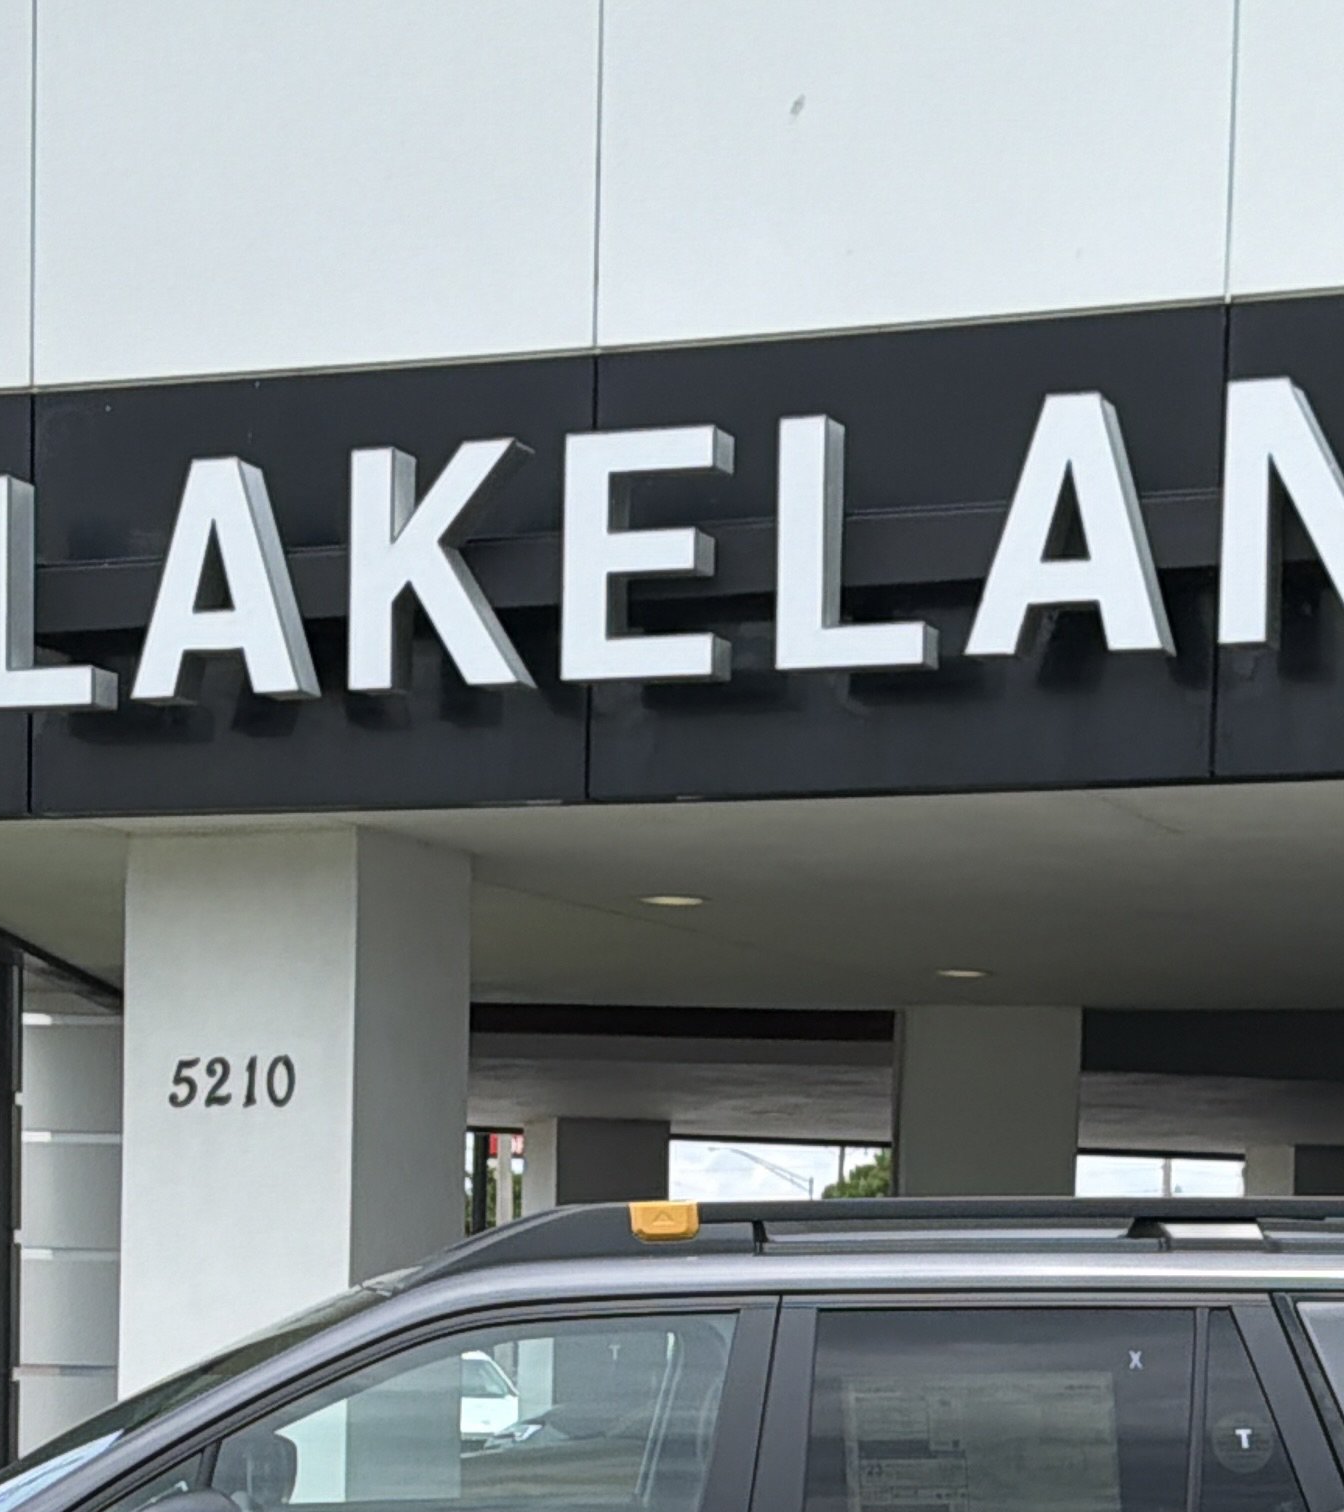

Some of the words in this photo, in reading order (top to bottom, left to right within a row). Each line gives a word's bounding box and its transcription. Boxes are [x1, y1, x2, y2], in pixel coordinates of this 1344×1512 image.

[168, 1053, 296, 1108] 5210
[1128, 1349, 1144, 1370] X
[1234, 1428, 1253, 1449] T
